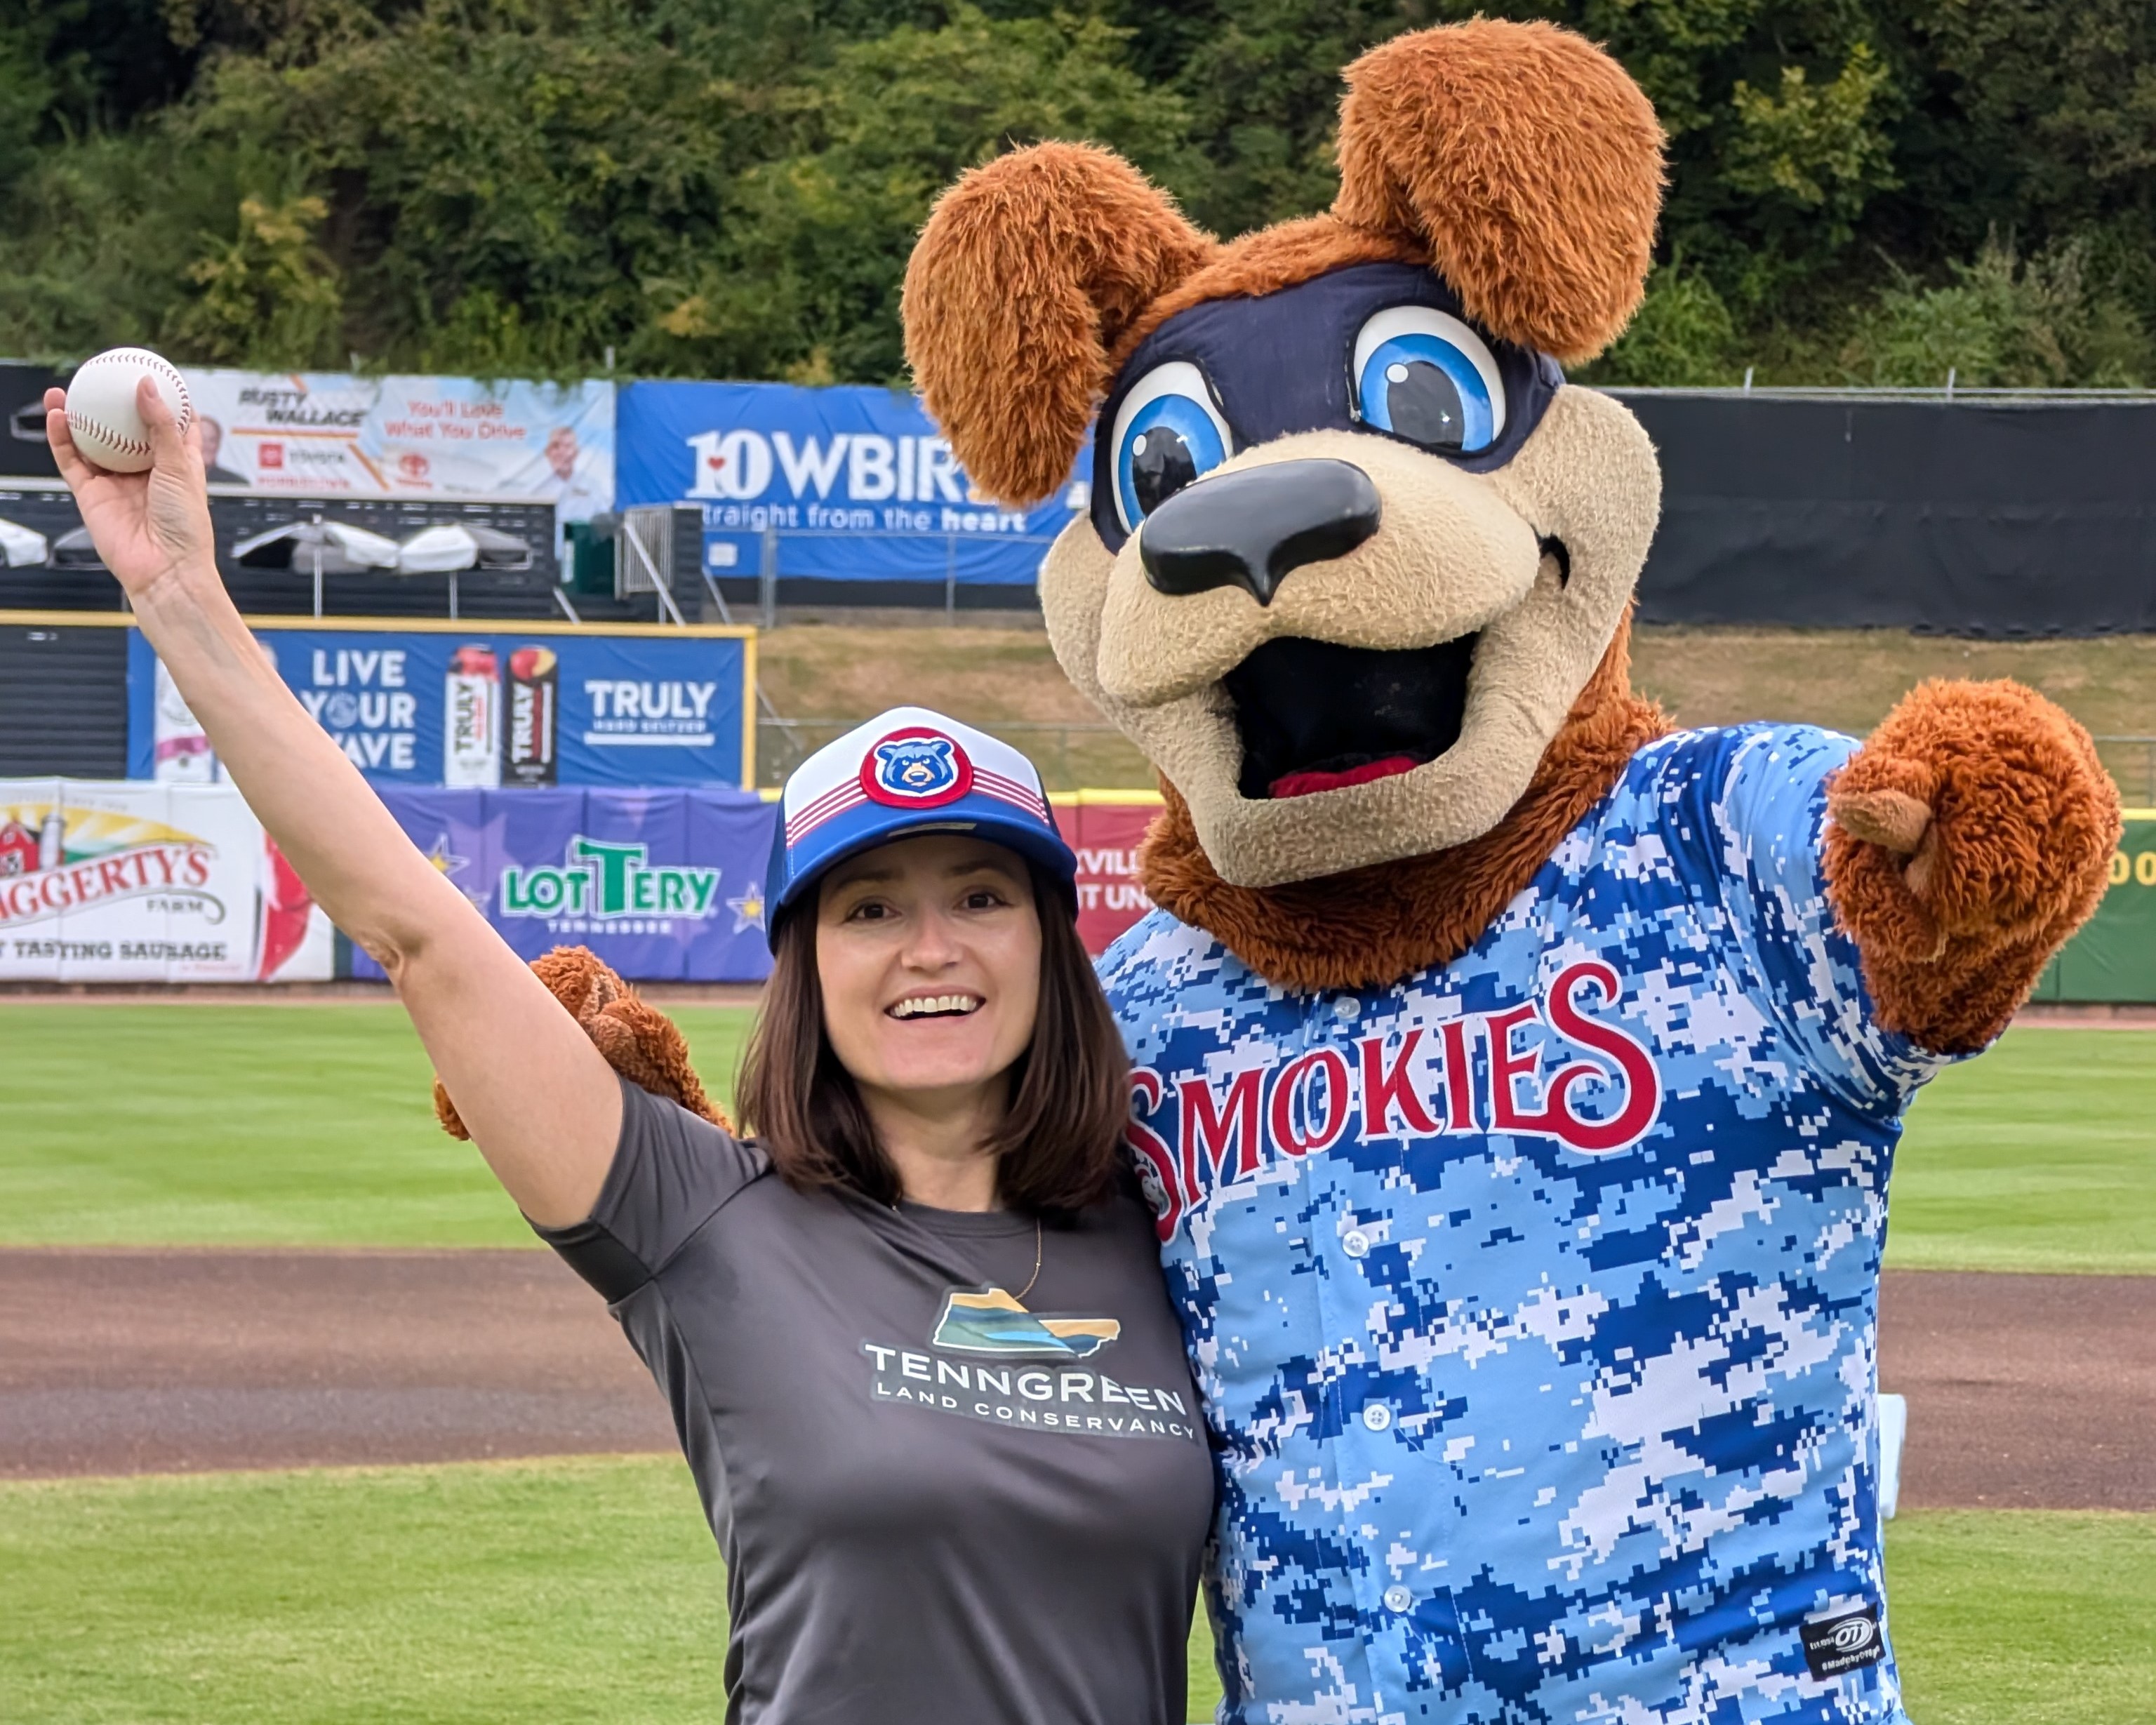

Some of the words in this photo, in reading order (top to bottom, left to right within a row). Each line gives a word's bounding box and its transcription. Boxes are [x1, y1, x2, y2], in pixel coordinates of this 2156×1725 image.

[239, 387, 307, 408] RUSTY
[407, 400, 455, 418] You'll
[460, 401, 505, 418] Love
[265, 407, 368, 427] WALLACE
[385, 421, 432, 438] What
[438, 422, 474, 440] You
[478, 423, 526, 441] Drive
[703, 503, 799, 532] traight
[808, 502, 872, 530] from
[884, 506, 931, 531] the
[941, 507, 1027, 532] heart
[312, 648, 406, 688] LIVE
[300, 689, 416, 729] YOUR
[584, 679, 717, 719] TRULY
[454, 682, 474, 755] TRULY
[503, 836, 720, 918] LOTTERY
[1105, 885, 1155, 911] UN
[547, 919, 673, 935] TENNESSEE
[15, 941, 114, 961] TASTING
[119, 940, 228, 961] SAUSAGE
[1123, 959, 1663, 1247] SMOKIES
[865, 1343, 1187, 1416] TENNGREEN
[876, 1382, 959, 1409] LAND
[973, 1402, 1195, 1440] CONSERVANCY
